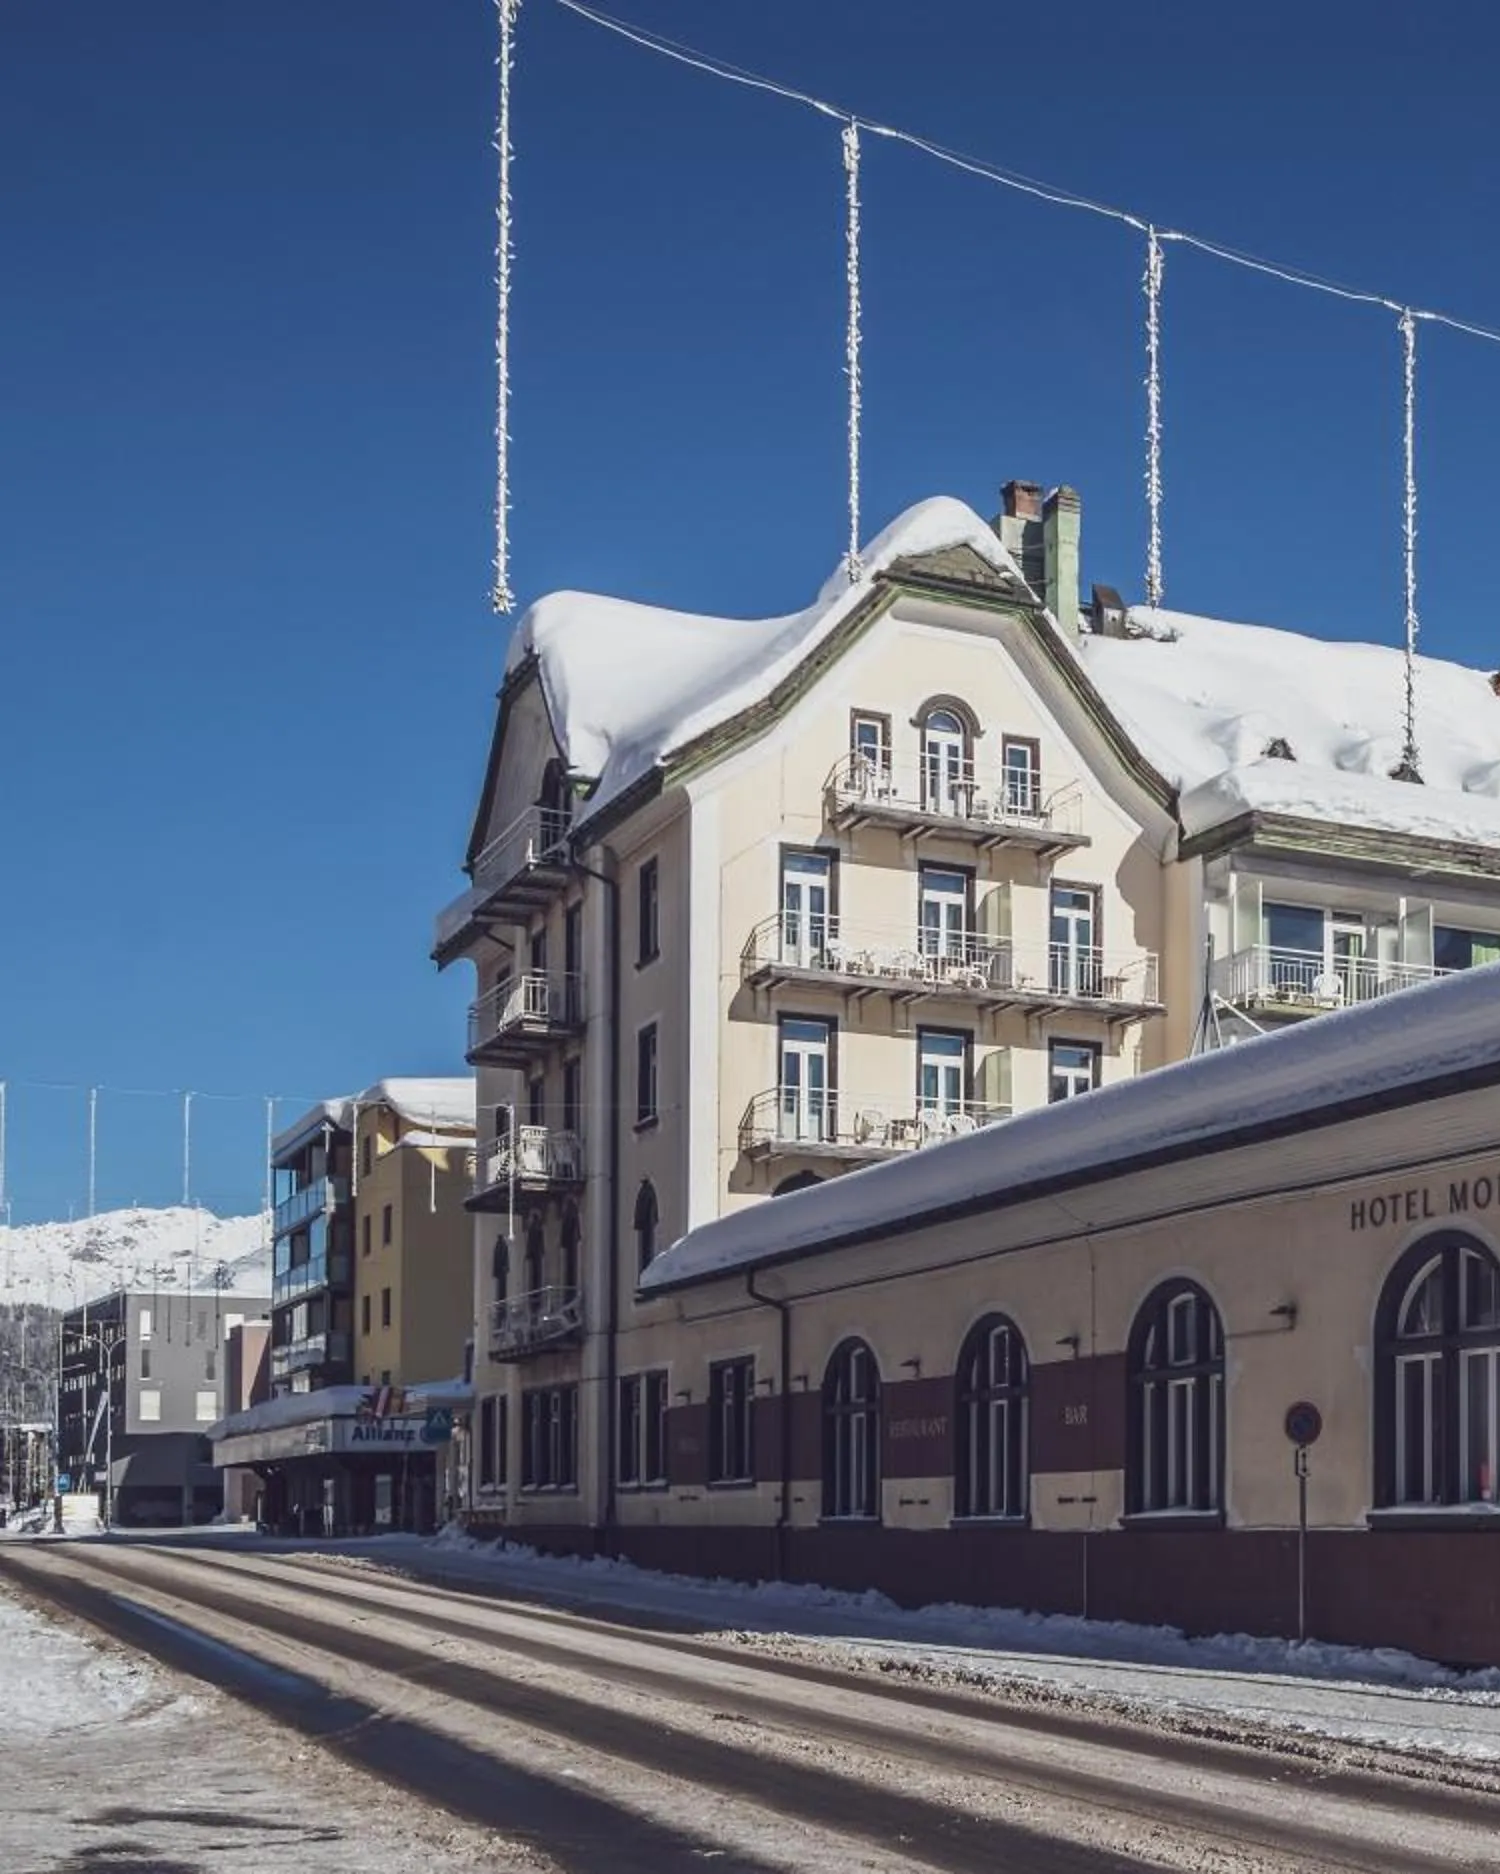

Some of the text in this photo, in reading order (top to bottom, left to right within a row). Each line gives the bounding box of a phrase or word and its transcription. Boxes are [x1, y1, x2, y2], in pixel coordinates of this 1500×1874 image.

[1350, 1188, 1435, 1231] HOTEL
[1065, 1405, 1088, 1425] BAR
[352, 1426, 416, 1441] Allianz
